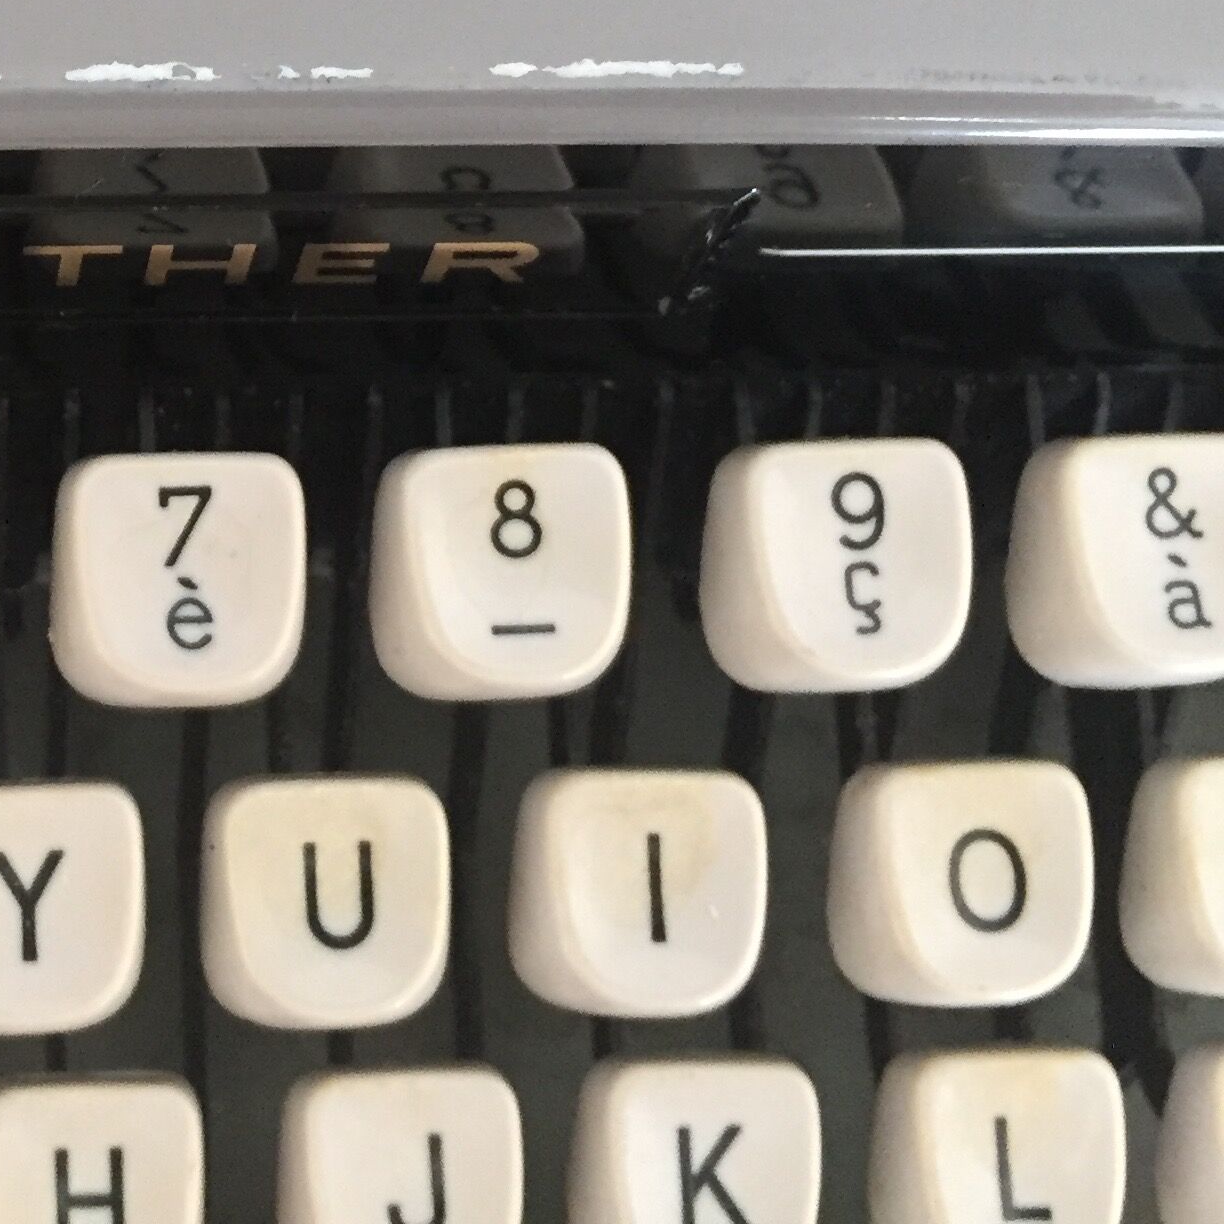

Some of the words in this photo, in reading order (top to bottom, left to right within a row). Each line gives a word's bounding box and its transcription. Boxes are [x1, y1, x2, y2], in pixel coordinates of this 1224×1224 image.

[158, 485, 213, 568] 7
[490, 479, 543, 560] 8
[830, 471, 886, 551] 9
[1145, 466, 1204, 540] &
[166, 576, 214, 651] è
[1164, 553, 1213, 630] à
[303, 840, 375, 951] U
[647, 833, 667, 943] I
[948, 828, 1028, 933] O
[54, 1146, 126, 1224] H
[387, 1133, 447, 1224] J
[677, 1124, 750, 1224] K
[994, 1117, 1053, 1222] L
